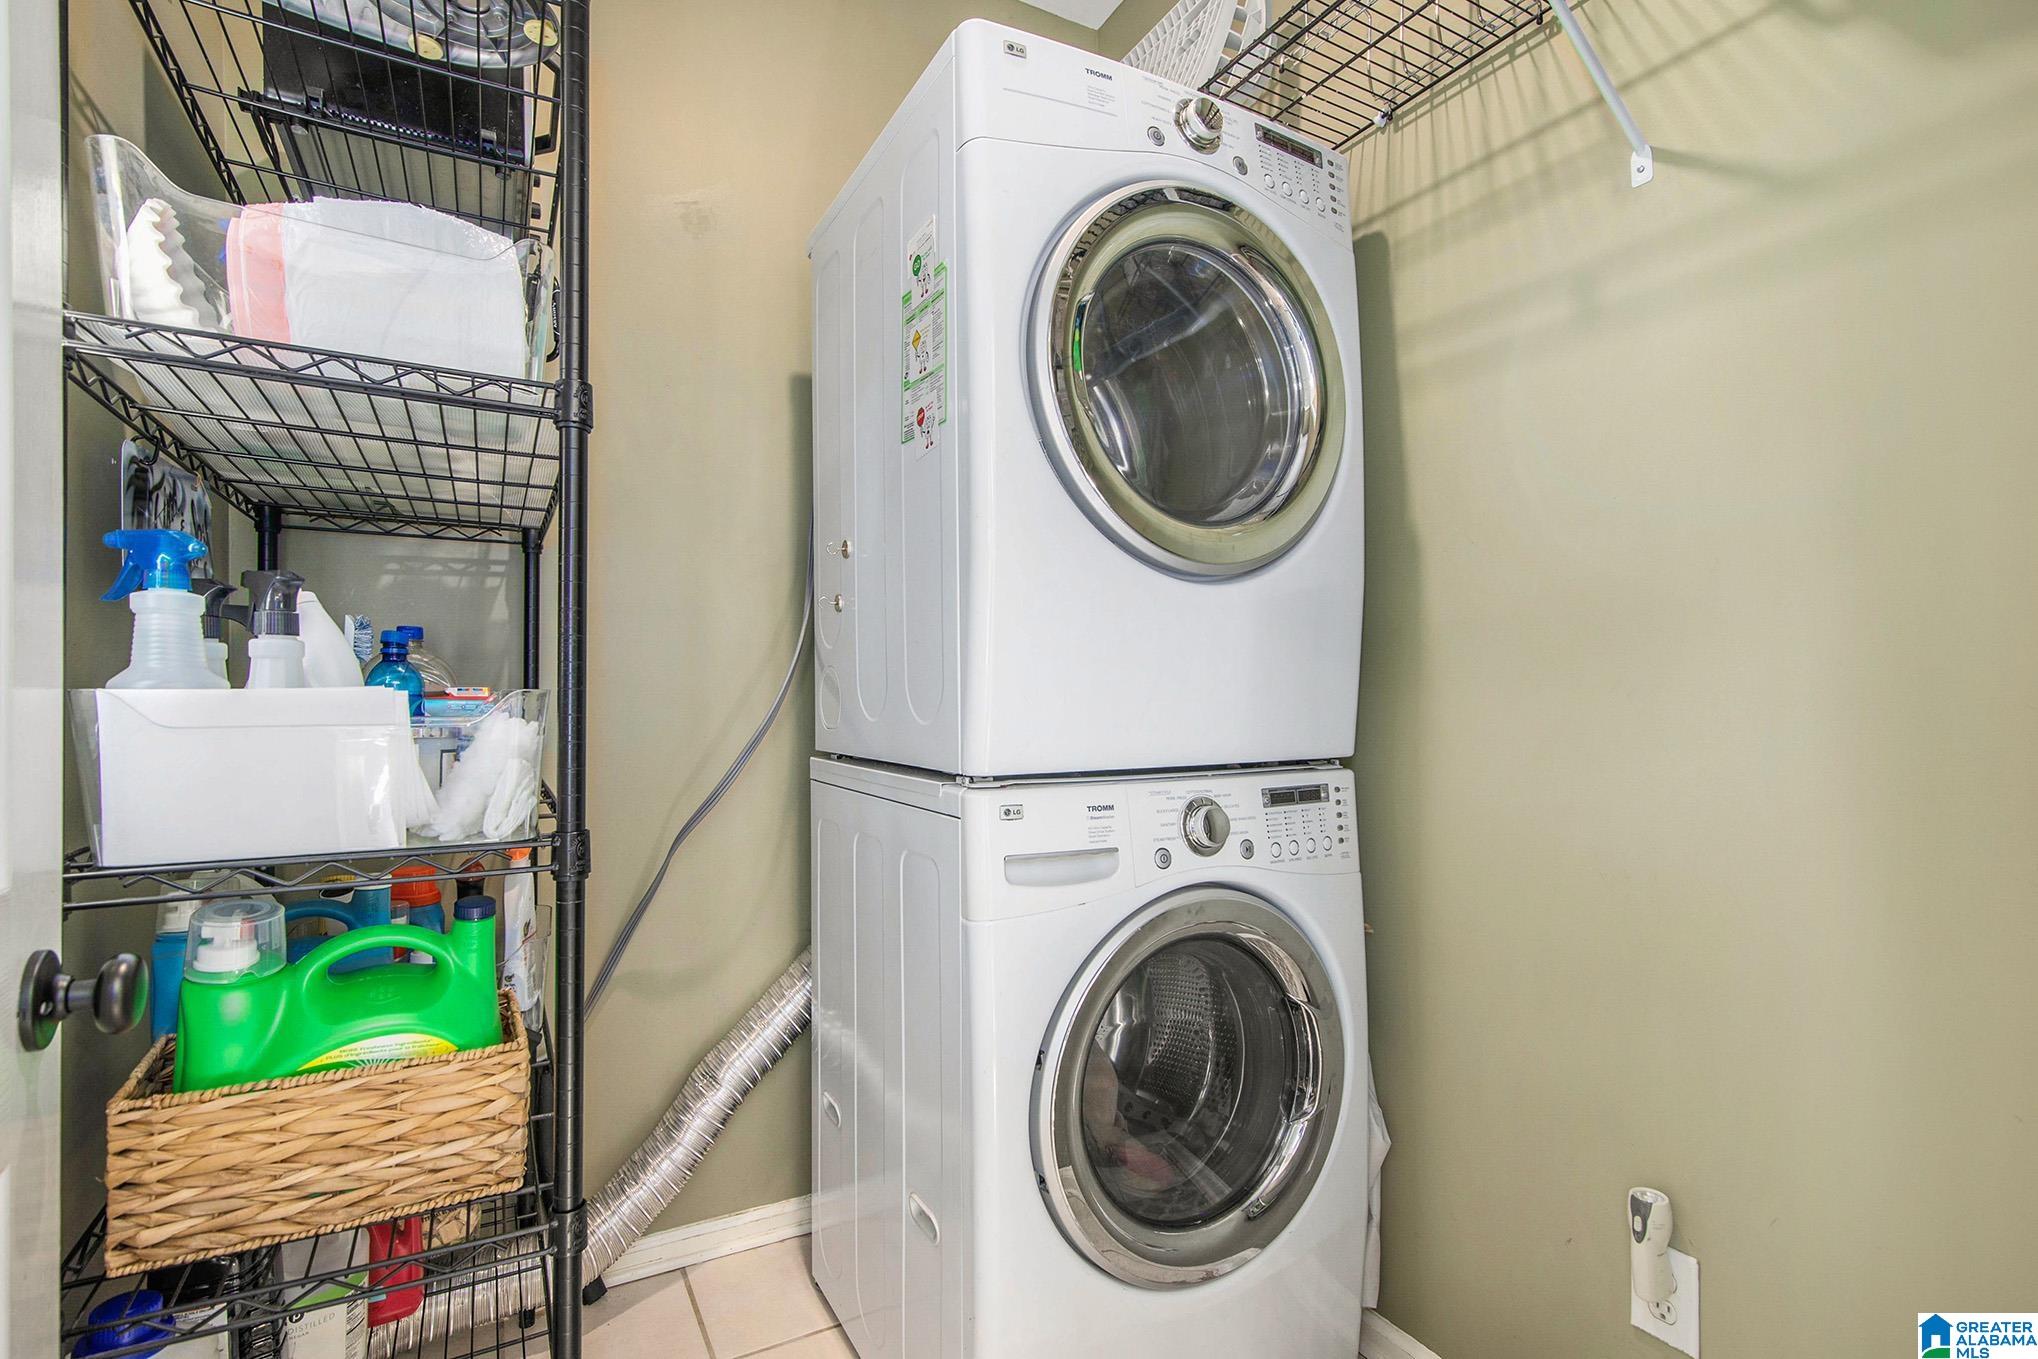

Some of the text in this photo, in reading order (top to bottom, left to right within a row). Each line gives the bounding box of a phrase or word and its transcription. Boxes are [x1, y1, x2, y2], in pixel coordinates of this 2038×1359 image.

[1085, 68, 1113, 81] TROMM
[1087, 804, 1115, 813] TROMM
[287, 1312, 336, 1336] DISTILLED
